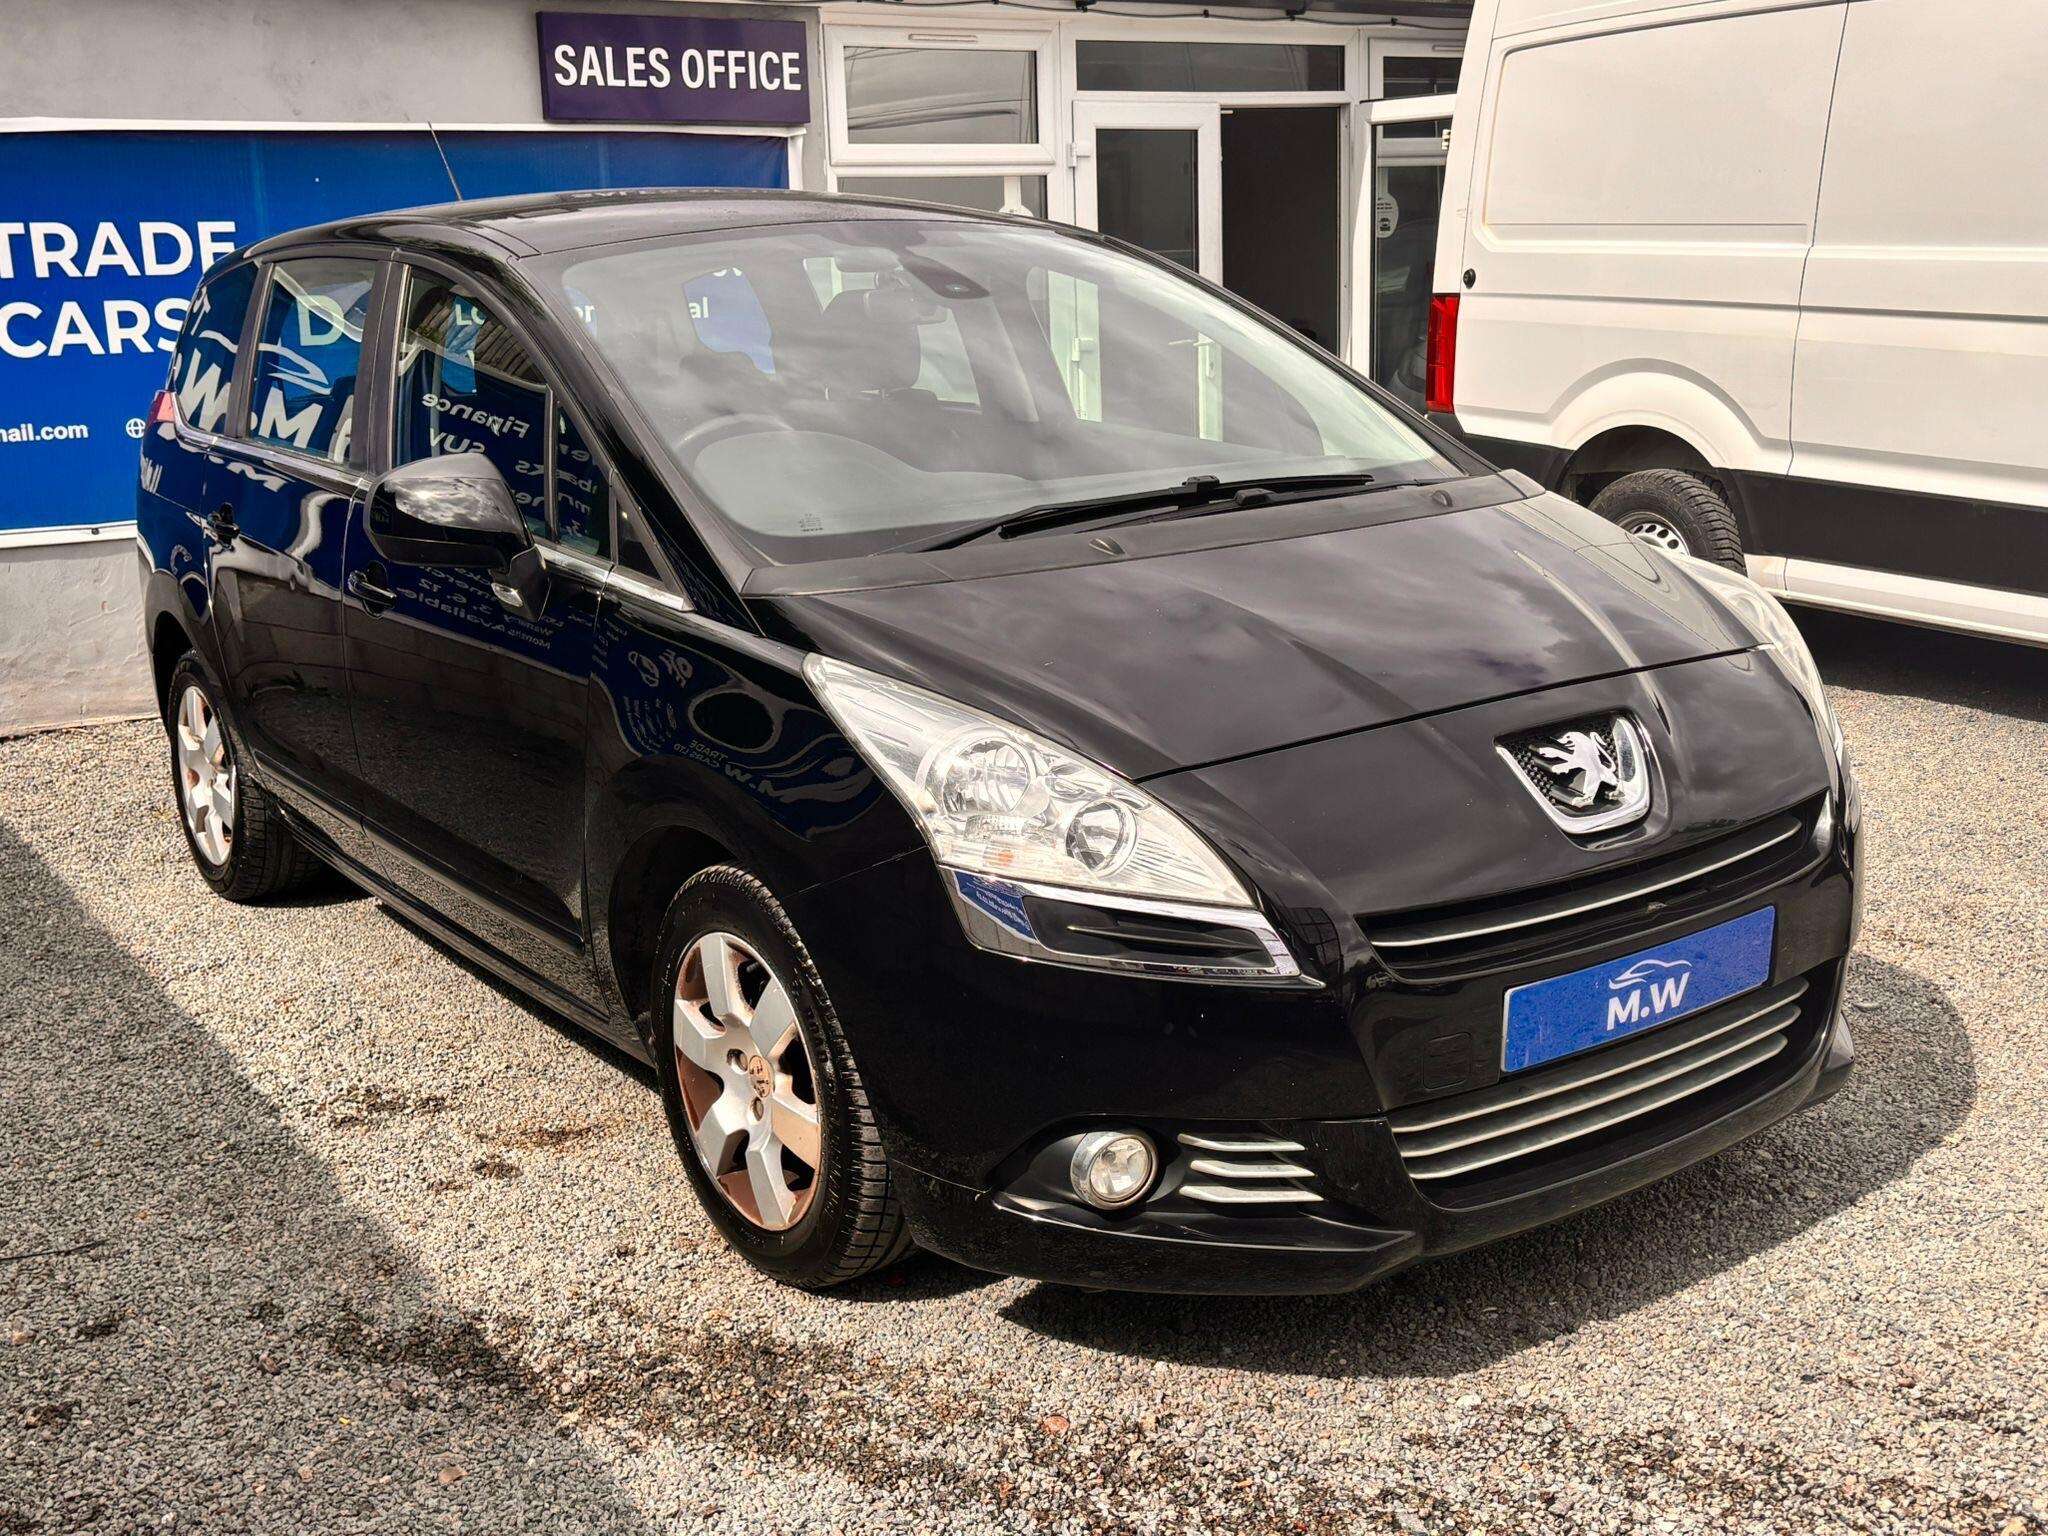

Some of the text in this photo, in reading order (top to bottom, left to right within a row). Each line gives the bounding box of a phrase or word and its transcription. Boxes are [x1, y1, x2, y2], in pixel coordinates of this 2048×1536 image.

[554, 44, 802, 91] SALES OFFICE
[0, 221, 236, 279] TRADE
[0, 299, 195, 358] CARS
[1606, 972, 1690, 1031] M.W
